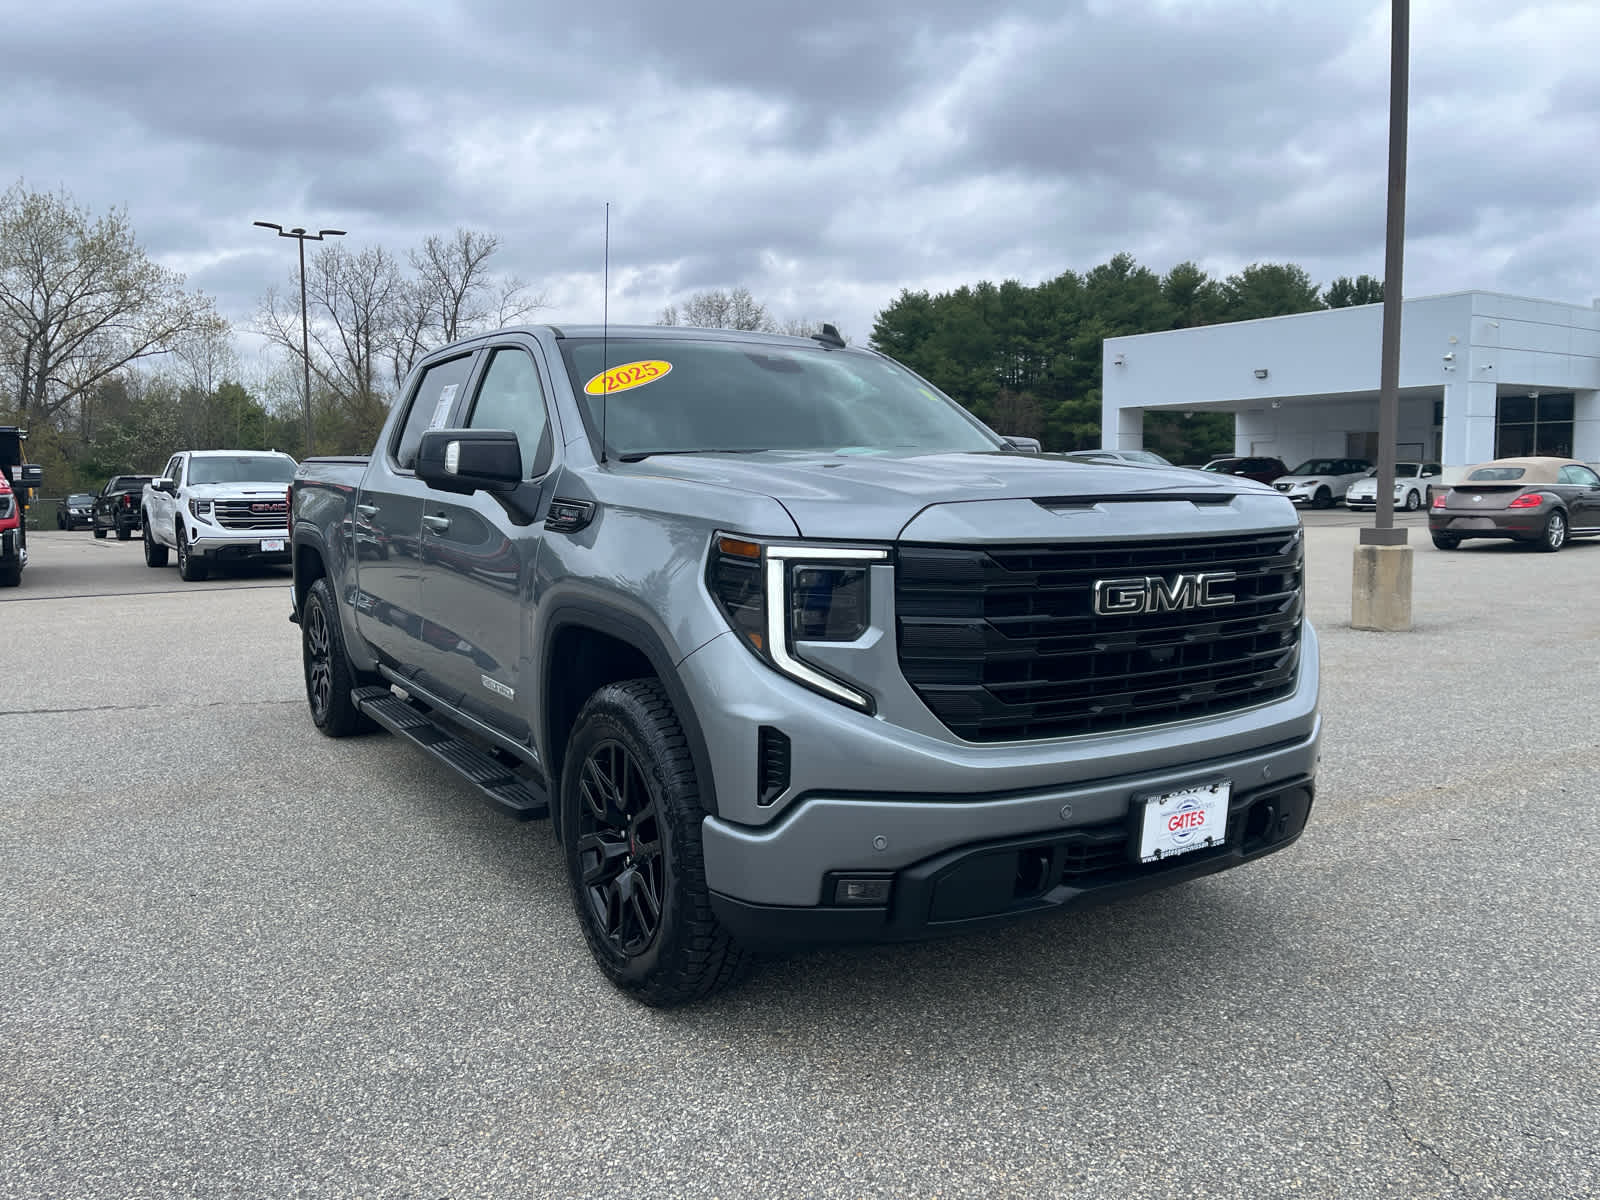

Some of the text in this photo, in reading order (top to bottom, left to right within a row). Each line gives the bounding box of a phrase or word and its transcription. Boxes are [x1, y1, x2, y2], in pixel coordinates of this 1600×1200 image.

[602, 363, 659, 391] 2025
[252, 503, 288, 512] GMC
[1094, 571, 1237, 616] GMC
[1168, 810, 1206, 832] GATES
